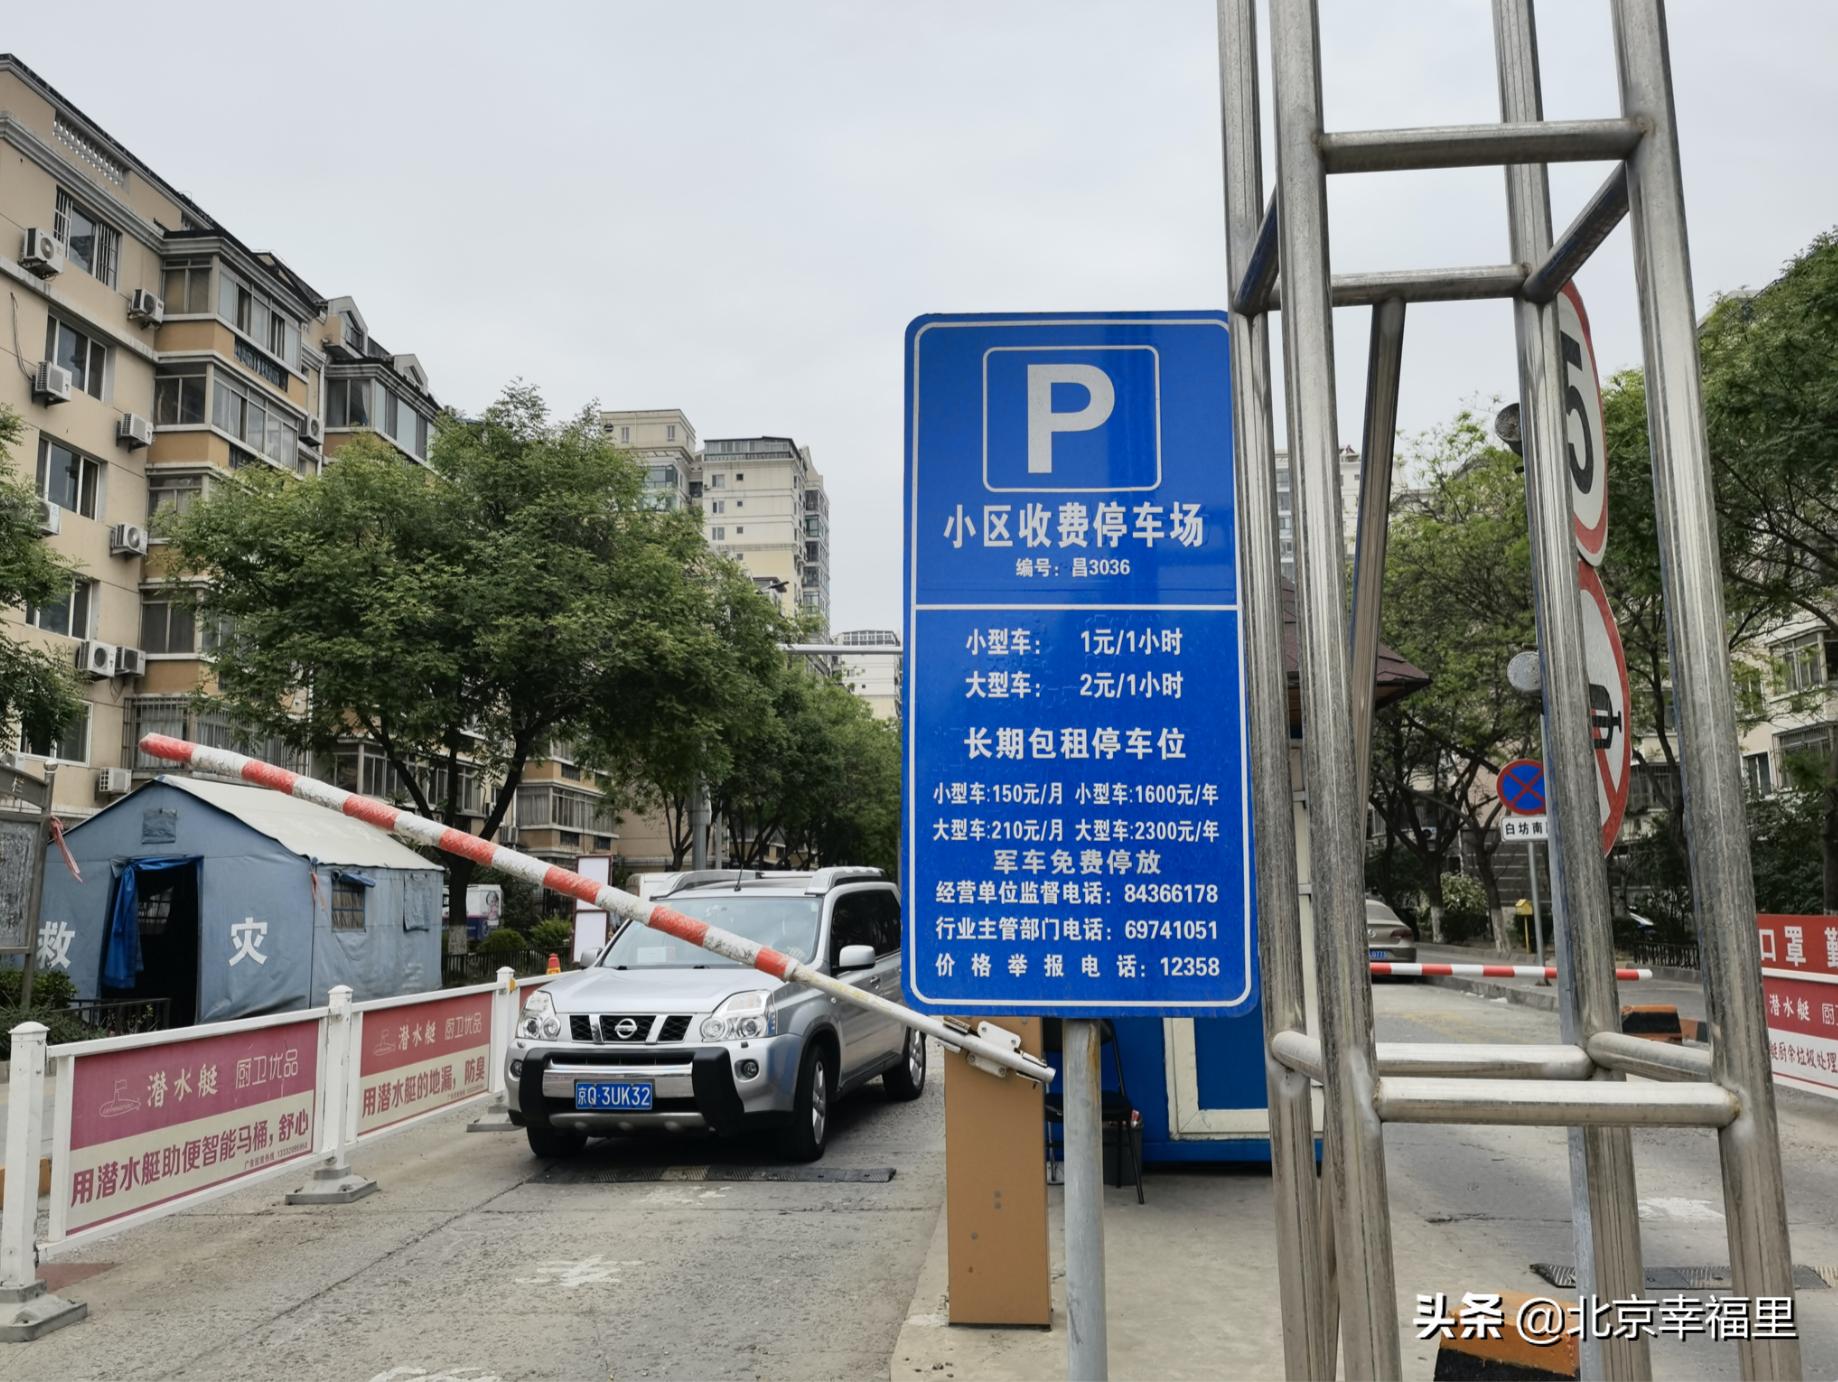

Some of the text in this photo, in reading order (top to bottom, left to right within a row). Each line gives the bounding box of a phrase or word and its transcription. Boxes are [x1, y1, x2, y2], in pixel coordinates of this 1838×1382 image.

[1027, 363, 1115, 474] P
[943, 501, 1204, 549] 小区收费停车场
[1080, 628, 1184, 656] 1元/1小时
[1080, 671, 1184, 699] 2元/1小时
[963, 727, 1187, 760] 长期包租停车位
[933, 782, 1219, 806] 小型车:150元/月 小型车:1600元/年
[933, 818, 1220, 843] 大型车:210元/月 大型车:2300元/年
[1505, 821, 1549, 835] 白坊南
[993, 849, 1162, 875] 军车免费停放
[36, 917, 269, 970] 救 灾
[1769, 993, 1838, 1026] 潜水艇 厨
[398, 1020, 436, 1051] 潜水艇
[146, 1048, 298, 1108] 潜水艇 厨卫优品
